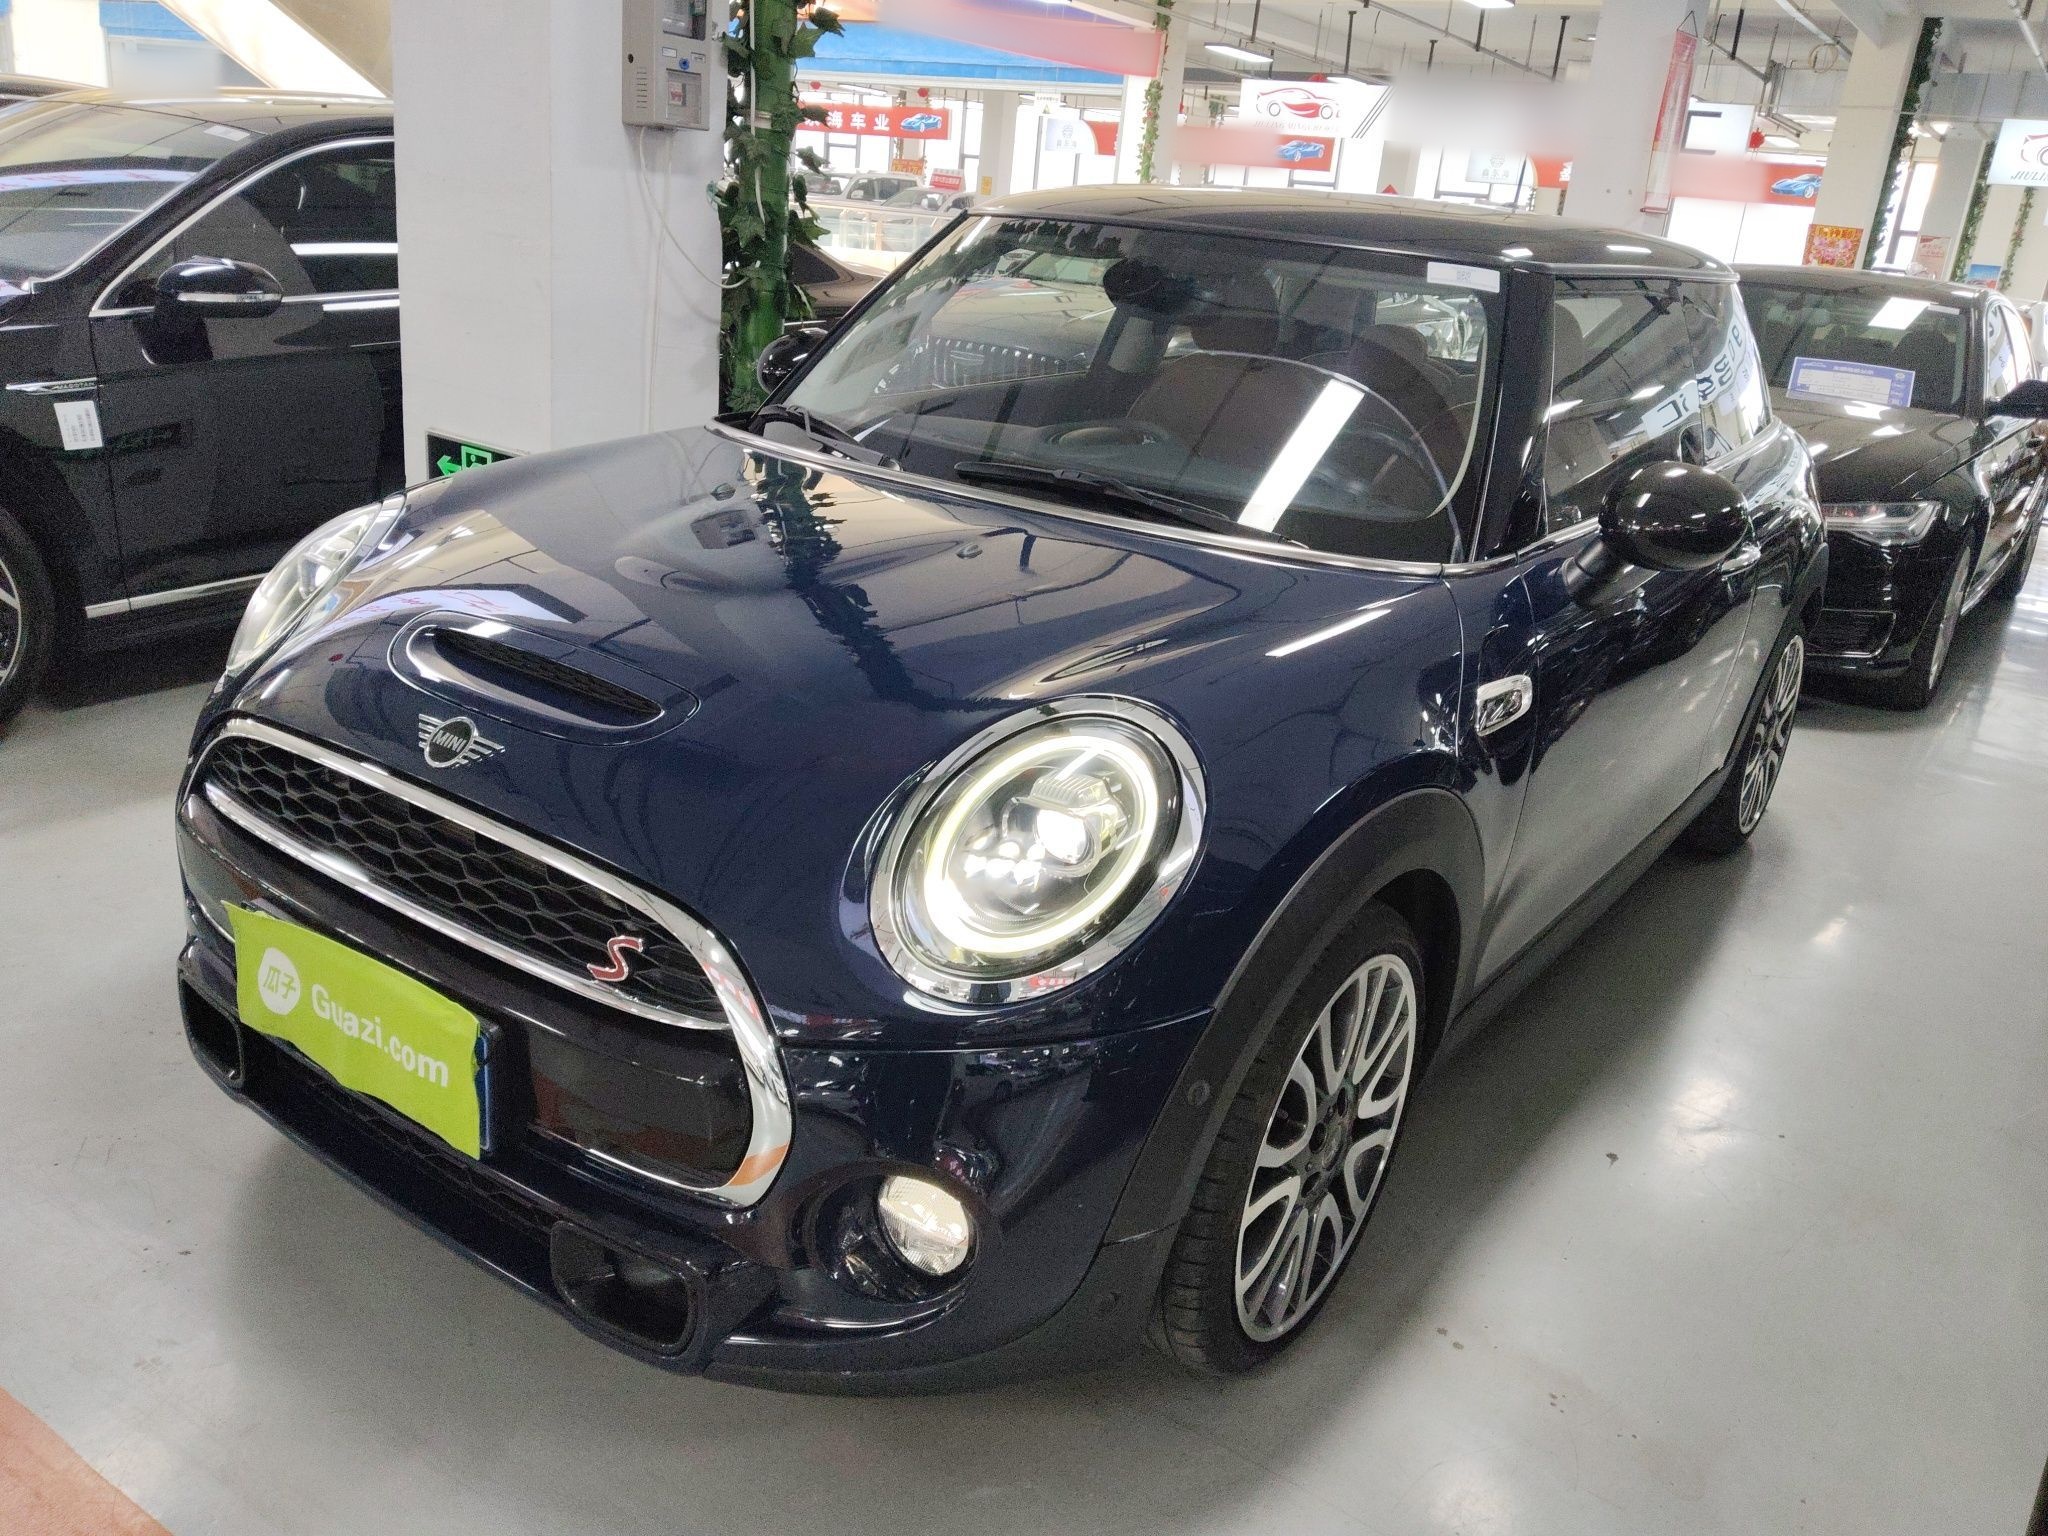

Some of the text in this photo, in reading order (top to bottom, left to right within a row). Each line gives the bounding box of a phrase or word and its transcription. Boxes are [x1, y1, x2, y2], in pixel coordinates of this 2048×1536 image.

[432, 730, 467, 753] MINI
[587, 935, 643, 981] S
[263, 965, 297, 1000] 瓜子
[311, 983, 449, 1088] Guazi.com
